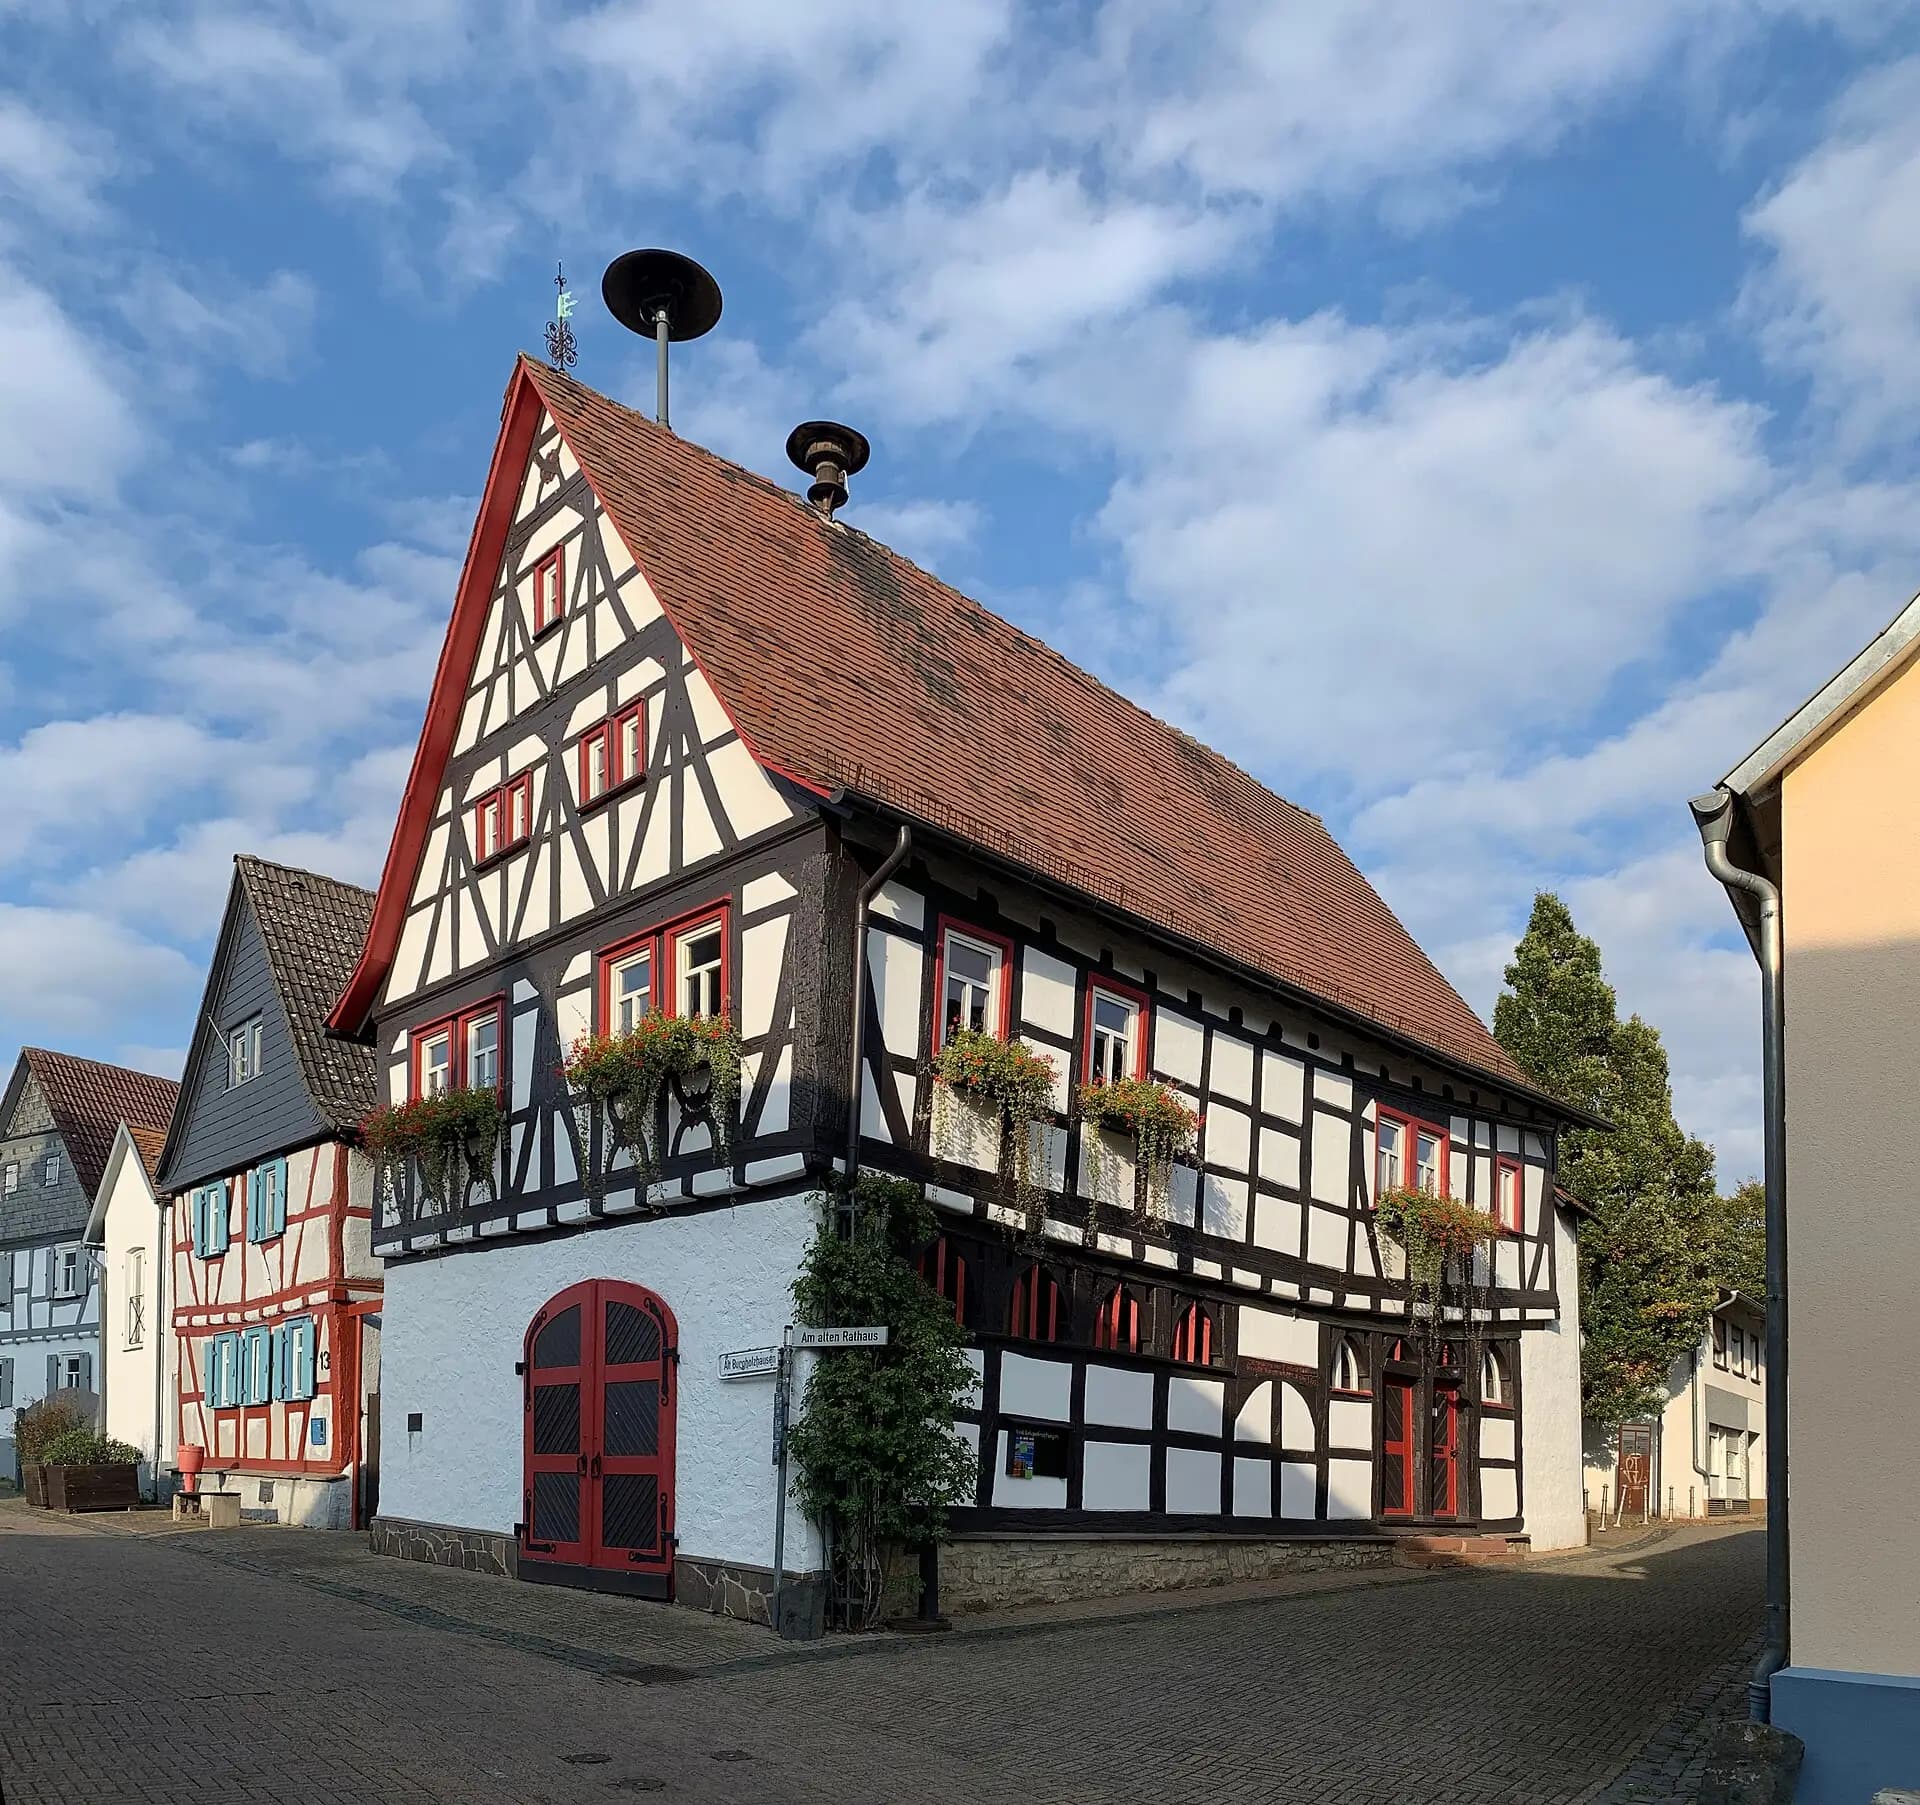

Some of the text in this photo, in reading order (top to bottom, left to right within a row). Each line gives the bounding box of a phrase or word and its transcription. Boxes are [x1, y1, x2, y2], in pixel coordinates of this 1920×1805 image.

[801, 1330, 878, 1343] Am alten Rathaus
[320, 1351, 331, 1370] 13
